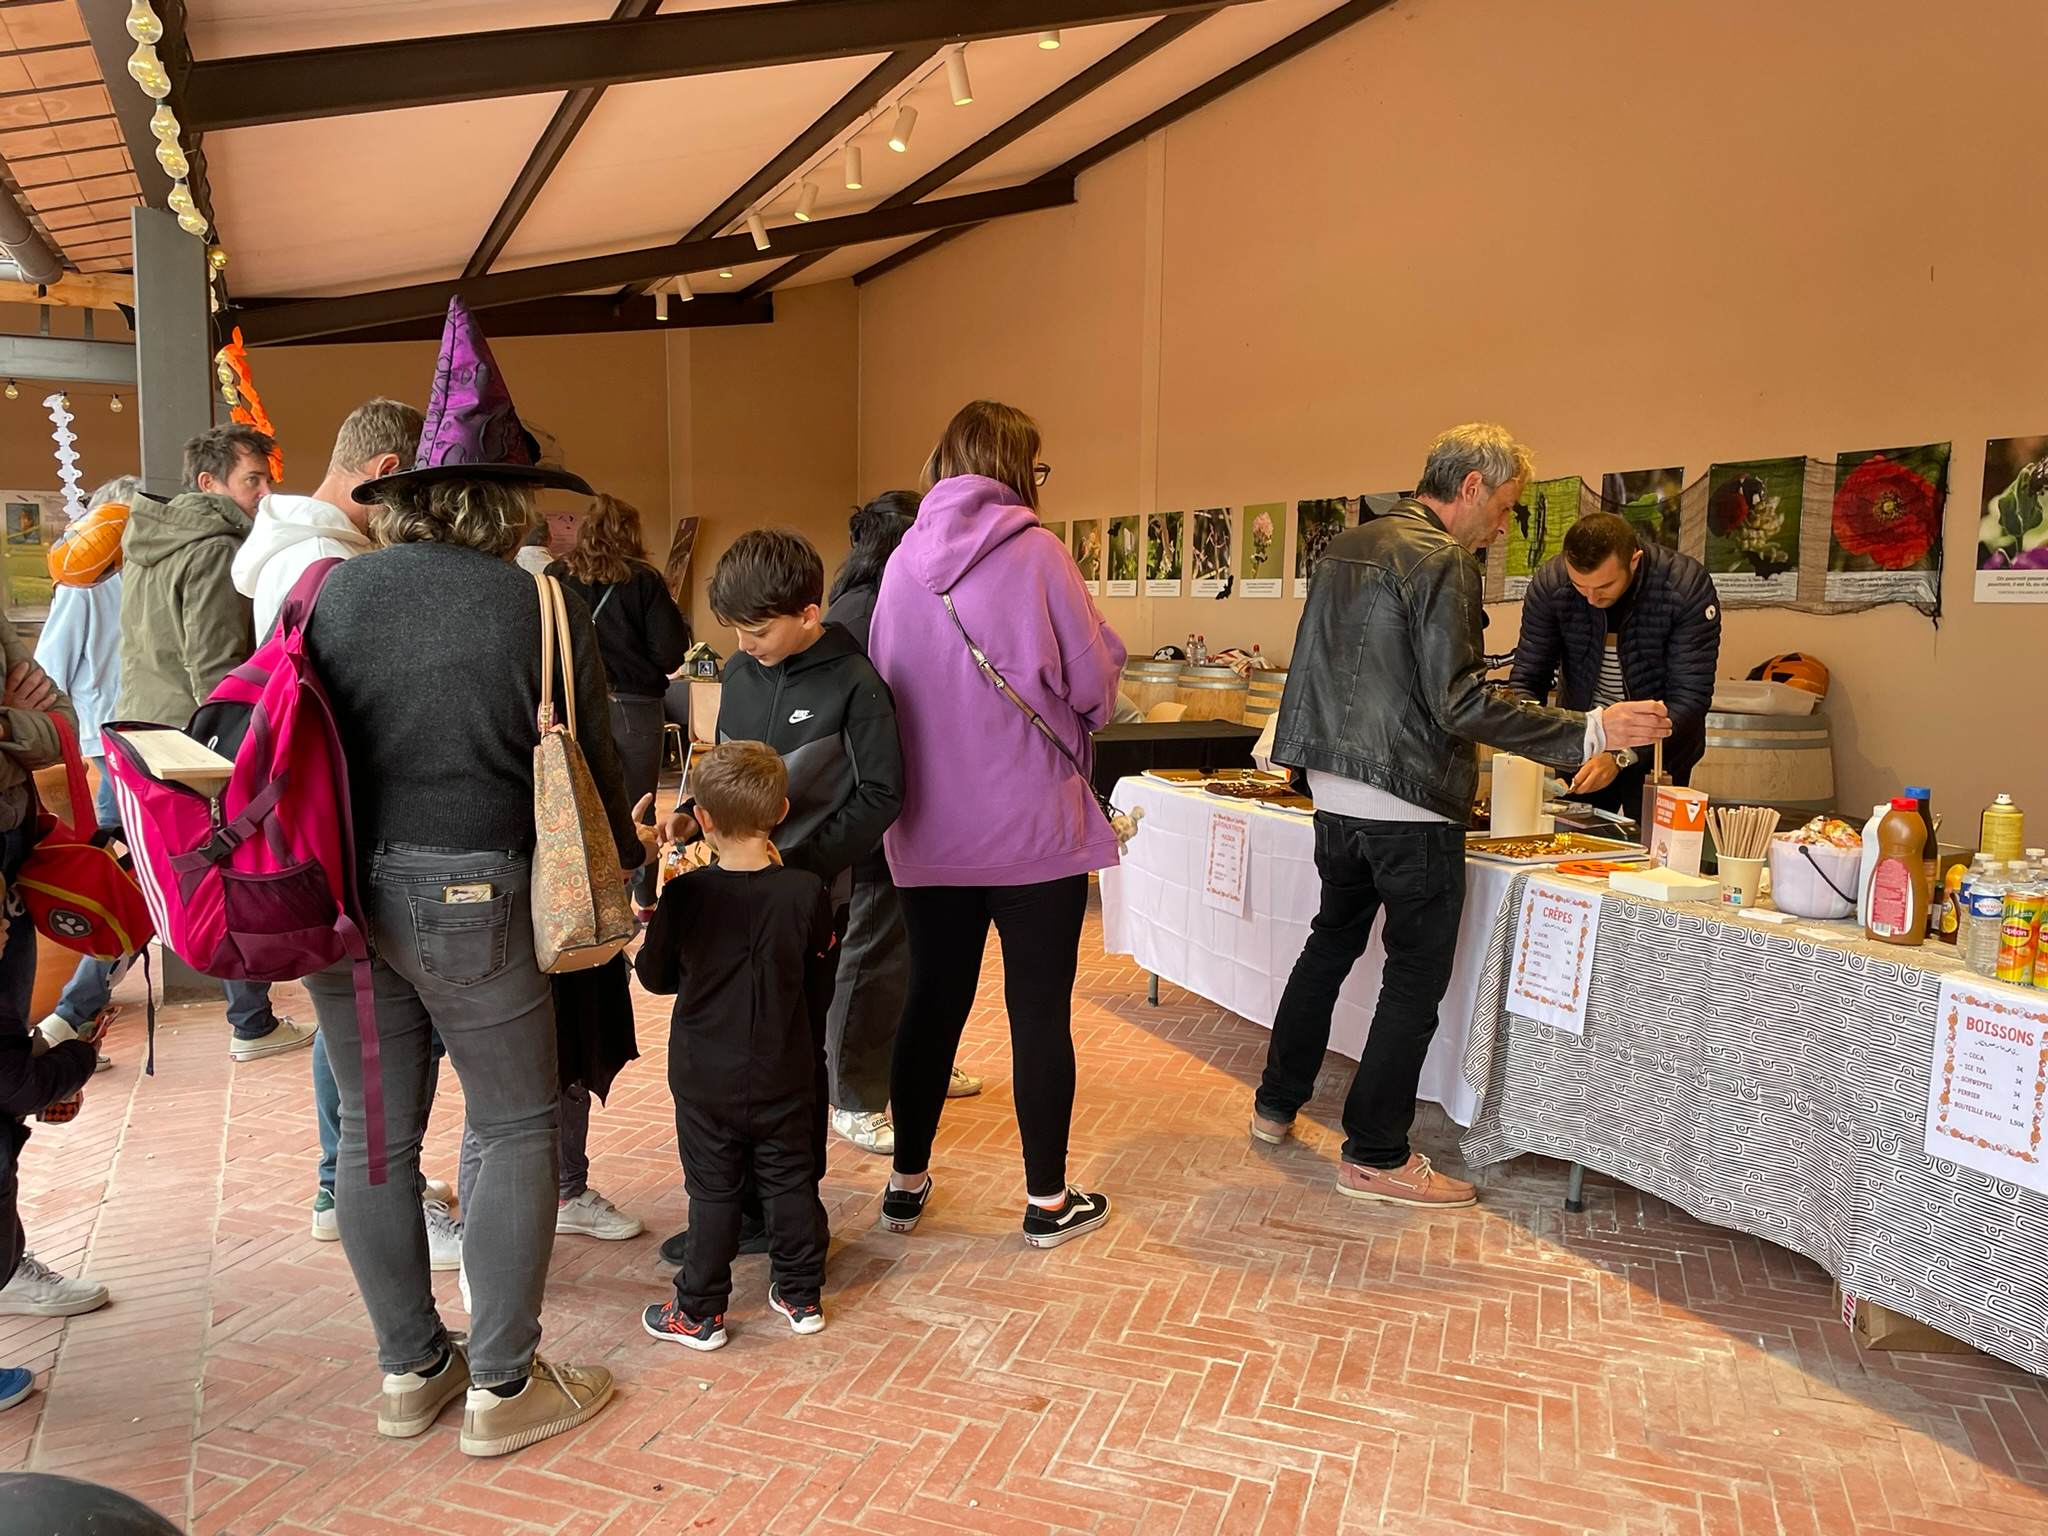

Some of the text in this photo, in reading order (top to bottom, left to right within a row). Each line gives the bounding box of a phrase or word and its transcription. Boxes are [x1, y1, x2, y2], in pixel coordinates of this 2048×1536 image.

[1543, 907, 1573, 924] CRÊPES
[2003, 927, 2027, 937] Lipton
[1966, 1016, 2034, 1047] BOISSONS
[1969, 1052, 1985, 1062] COCA
[1964, 1063, 1974, 1072] ICE
[1976, 1066, 1987, 1075] TEA
[1961, 1076, 1993, 1090] SCHWEPPES
[1957, 1088, 1981, 1099] PERRIER
[1954, 1101, 1983, 1115] BOUTEILLE
[1985, 1110, 2002, 1121] D'EAU
